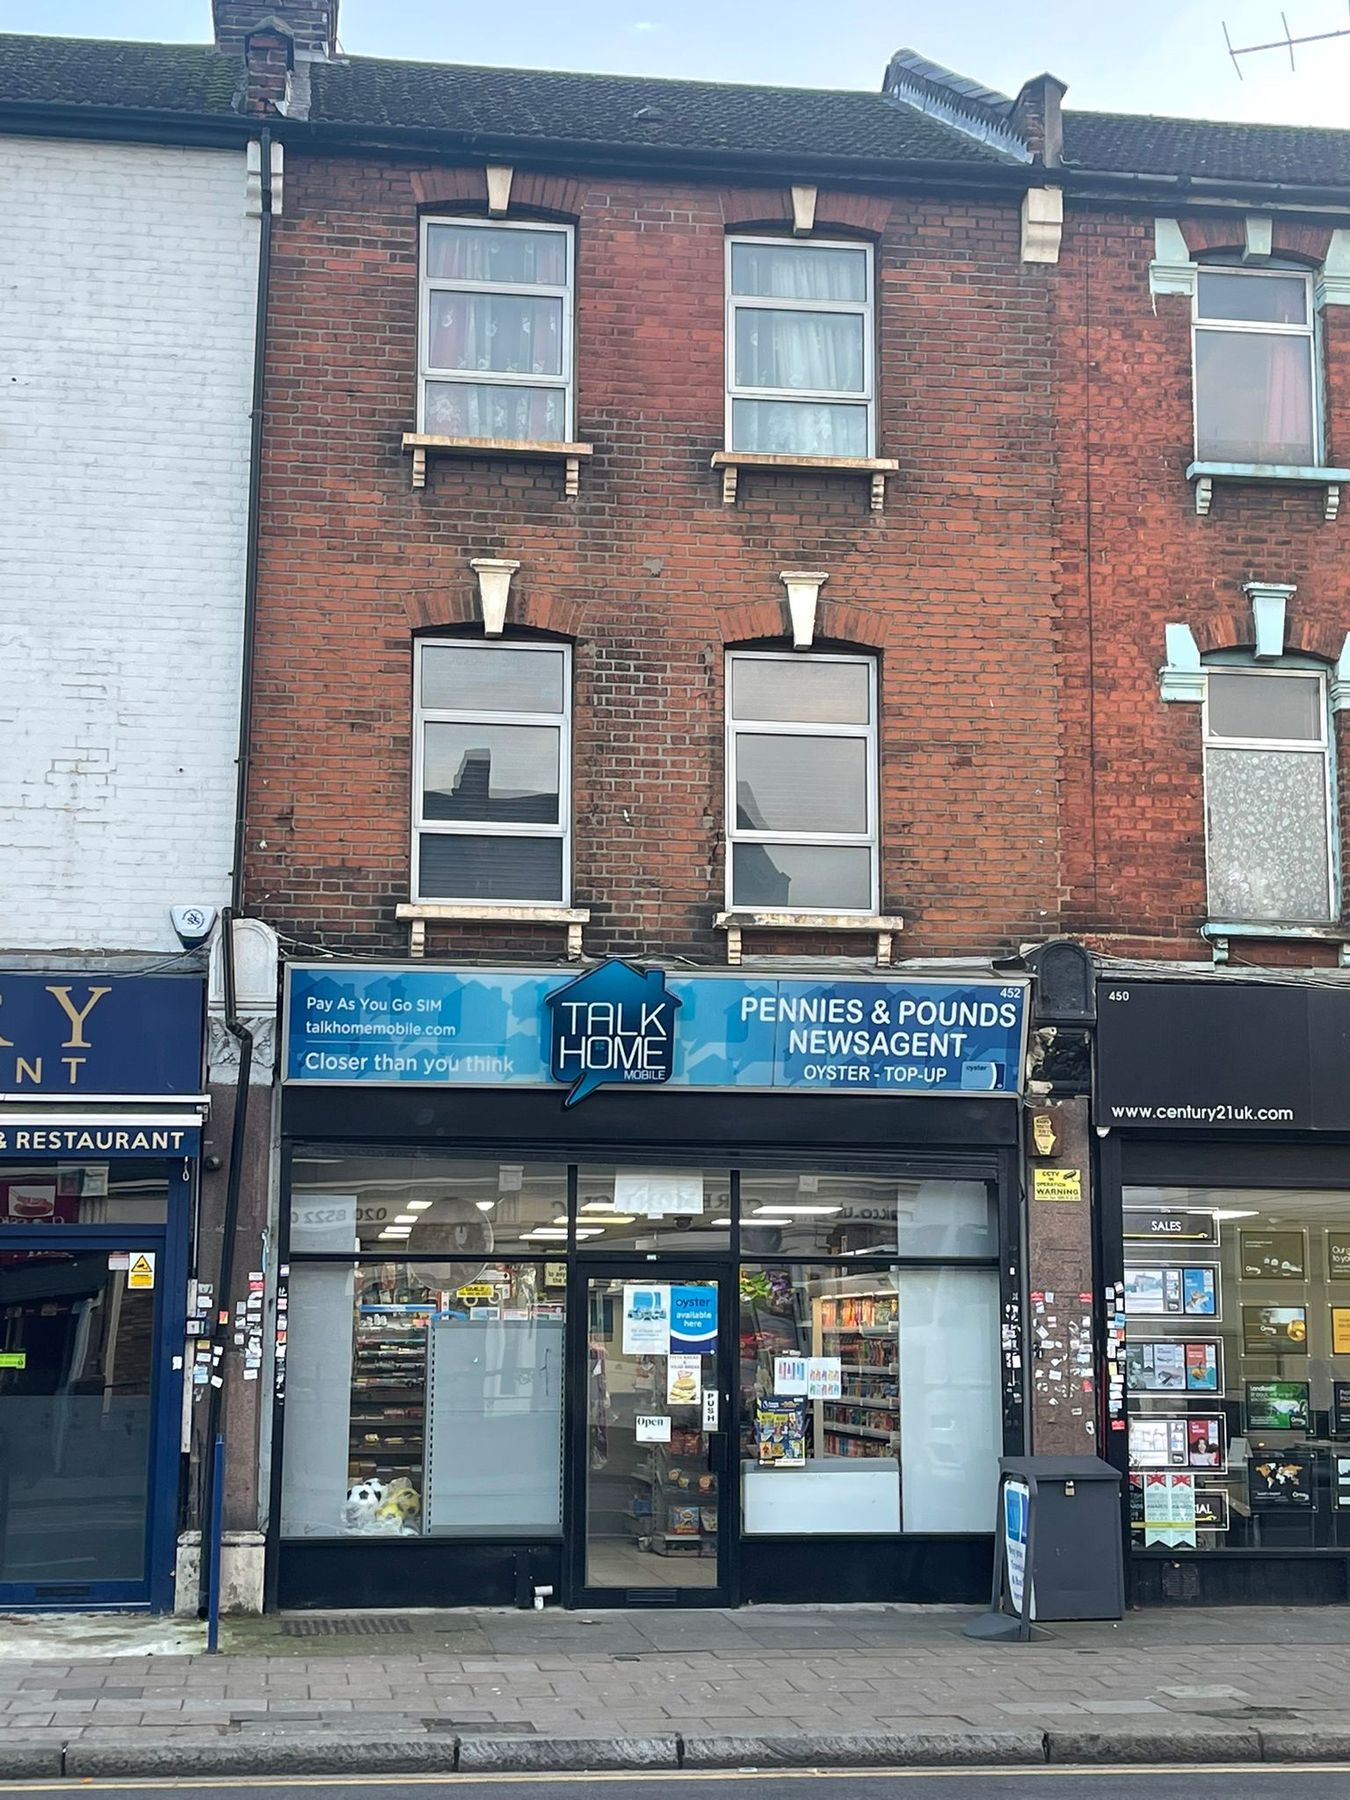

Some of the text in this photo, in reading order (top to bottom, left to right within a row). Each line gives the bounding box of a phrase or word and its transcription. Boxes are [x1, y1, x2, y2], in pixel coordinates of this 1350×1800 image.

[999, 988, 1021, 999] 452
[1108, 991, 1130, 1001] 450
[307, 996, 442, 1013] Pay As You Go SIM
[740, 997, 1017, 1028] PENNIES & POUNDS
[561, 1002, 667, 1036] TALK
[305, 1020, 456, 1036] talkhomemobile.com
[559, 1036, 667, 1070] HOME
[788, 1030, 968, 1059] NEWSAGENT
[305, 1052, 514, 1075] Closer than you think
[623, 1070, 666, 1081] MOBILE
[803, 1064, 870, 1083] OYSTER
[884, 1067, 948, 1084] TOP-UP
[1111, 1105, 1294, 1122] www.century21uk.com
[16, 1131, 185, 1150] RESTAURANT
[1151, 1220, 1182, 1231] SALES
[676, 1297, 712, 1309] oyster
[676, 1311, 713, 1320] available
[683, 1319, 702, 1328] here
[707, 1392, 715, 1422] PUSH
[637, 1417, 664, 1427] Open
